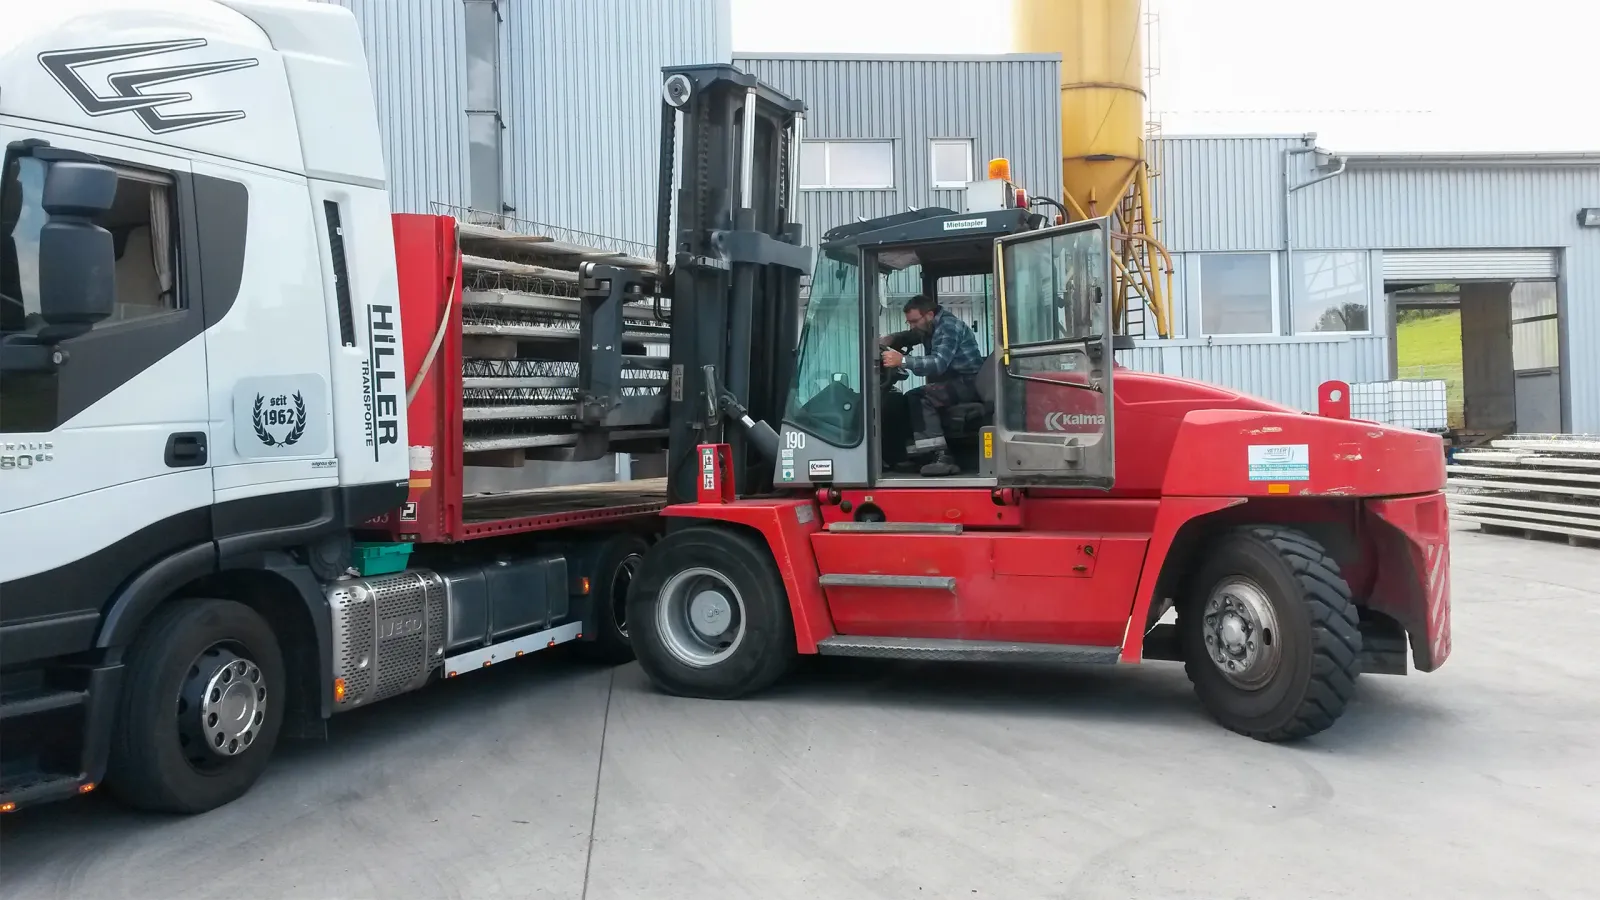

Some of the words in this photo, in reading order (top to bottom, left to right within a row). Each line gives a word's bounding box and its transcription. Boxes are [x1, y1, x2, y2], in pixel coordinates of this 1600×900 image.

[946, 220, 984, 229] Mietstapler
[372, 304, 398, 445] HILLER
[270, 395, 287, 406] seit
[361, 358, 373, 447] TRANSPORTE
[263, 409, 295, 425] 1962
[785, 431, 806, 449] 190
[379, 619, 422, 639] IVECO
